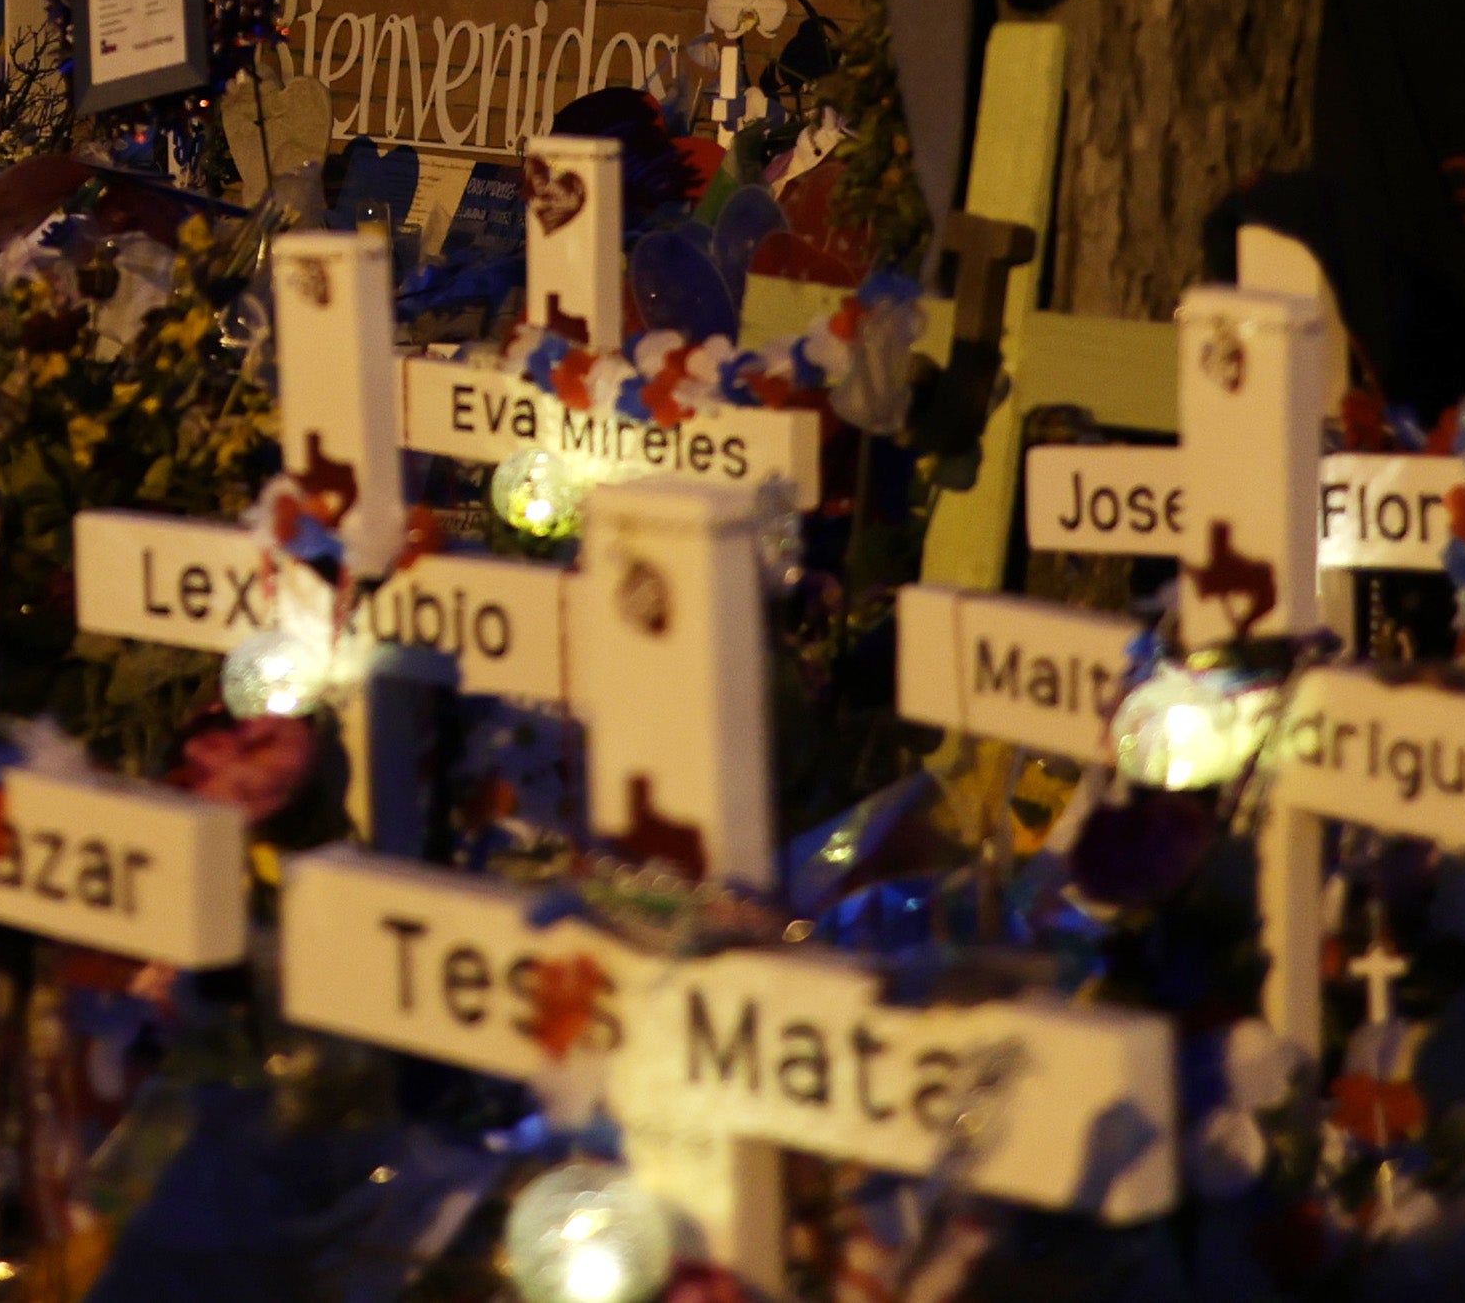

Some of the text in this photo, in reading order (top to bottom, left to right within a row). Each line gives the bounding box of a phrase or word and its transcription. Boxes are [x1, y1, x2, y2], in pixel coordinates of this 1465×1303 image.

[452, 384, 749, 478] Eva Mireles
[685, 986, 971, 1130] Mata
